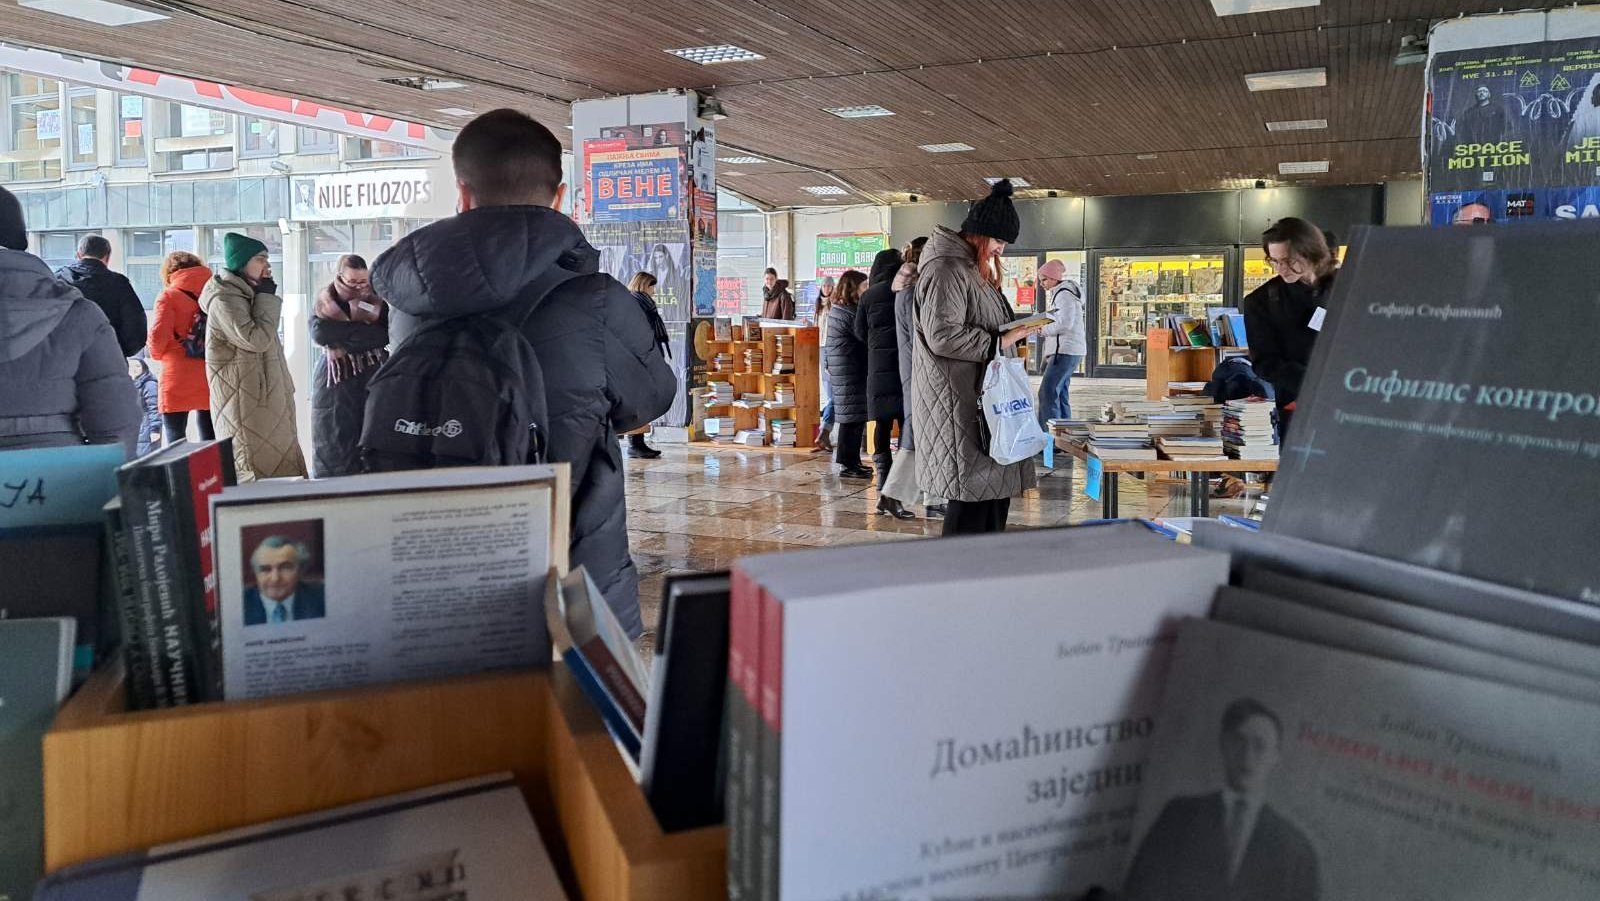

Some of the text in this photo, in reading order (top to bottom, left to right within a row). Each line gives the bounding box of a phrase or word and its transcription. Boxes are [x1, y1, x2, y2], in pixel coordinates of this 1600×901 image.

[1563, 63, 1600, 72] REPRIS
[1455, 140, 1523, 156] SPACE
[1448, 153, 1530, 170] MOTION
[319, 184, 353, 208] NIJE
[598, 174, 673, 199] ВЕНЕ
[820, 251, 877, 265] BRAVO BRAV
[1344, 367, 1471, 403] Сифилис
[146, 500, 164, 542] Мира
[153, 544, 175, 619] Радојевић
[929, 714, 1154, 778] Домаћинство
[1026, 760, 1145, 807] заједни
